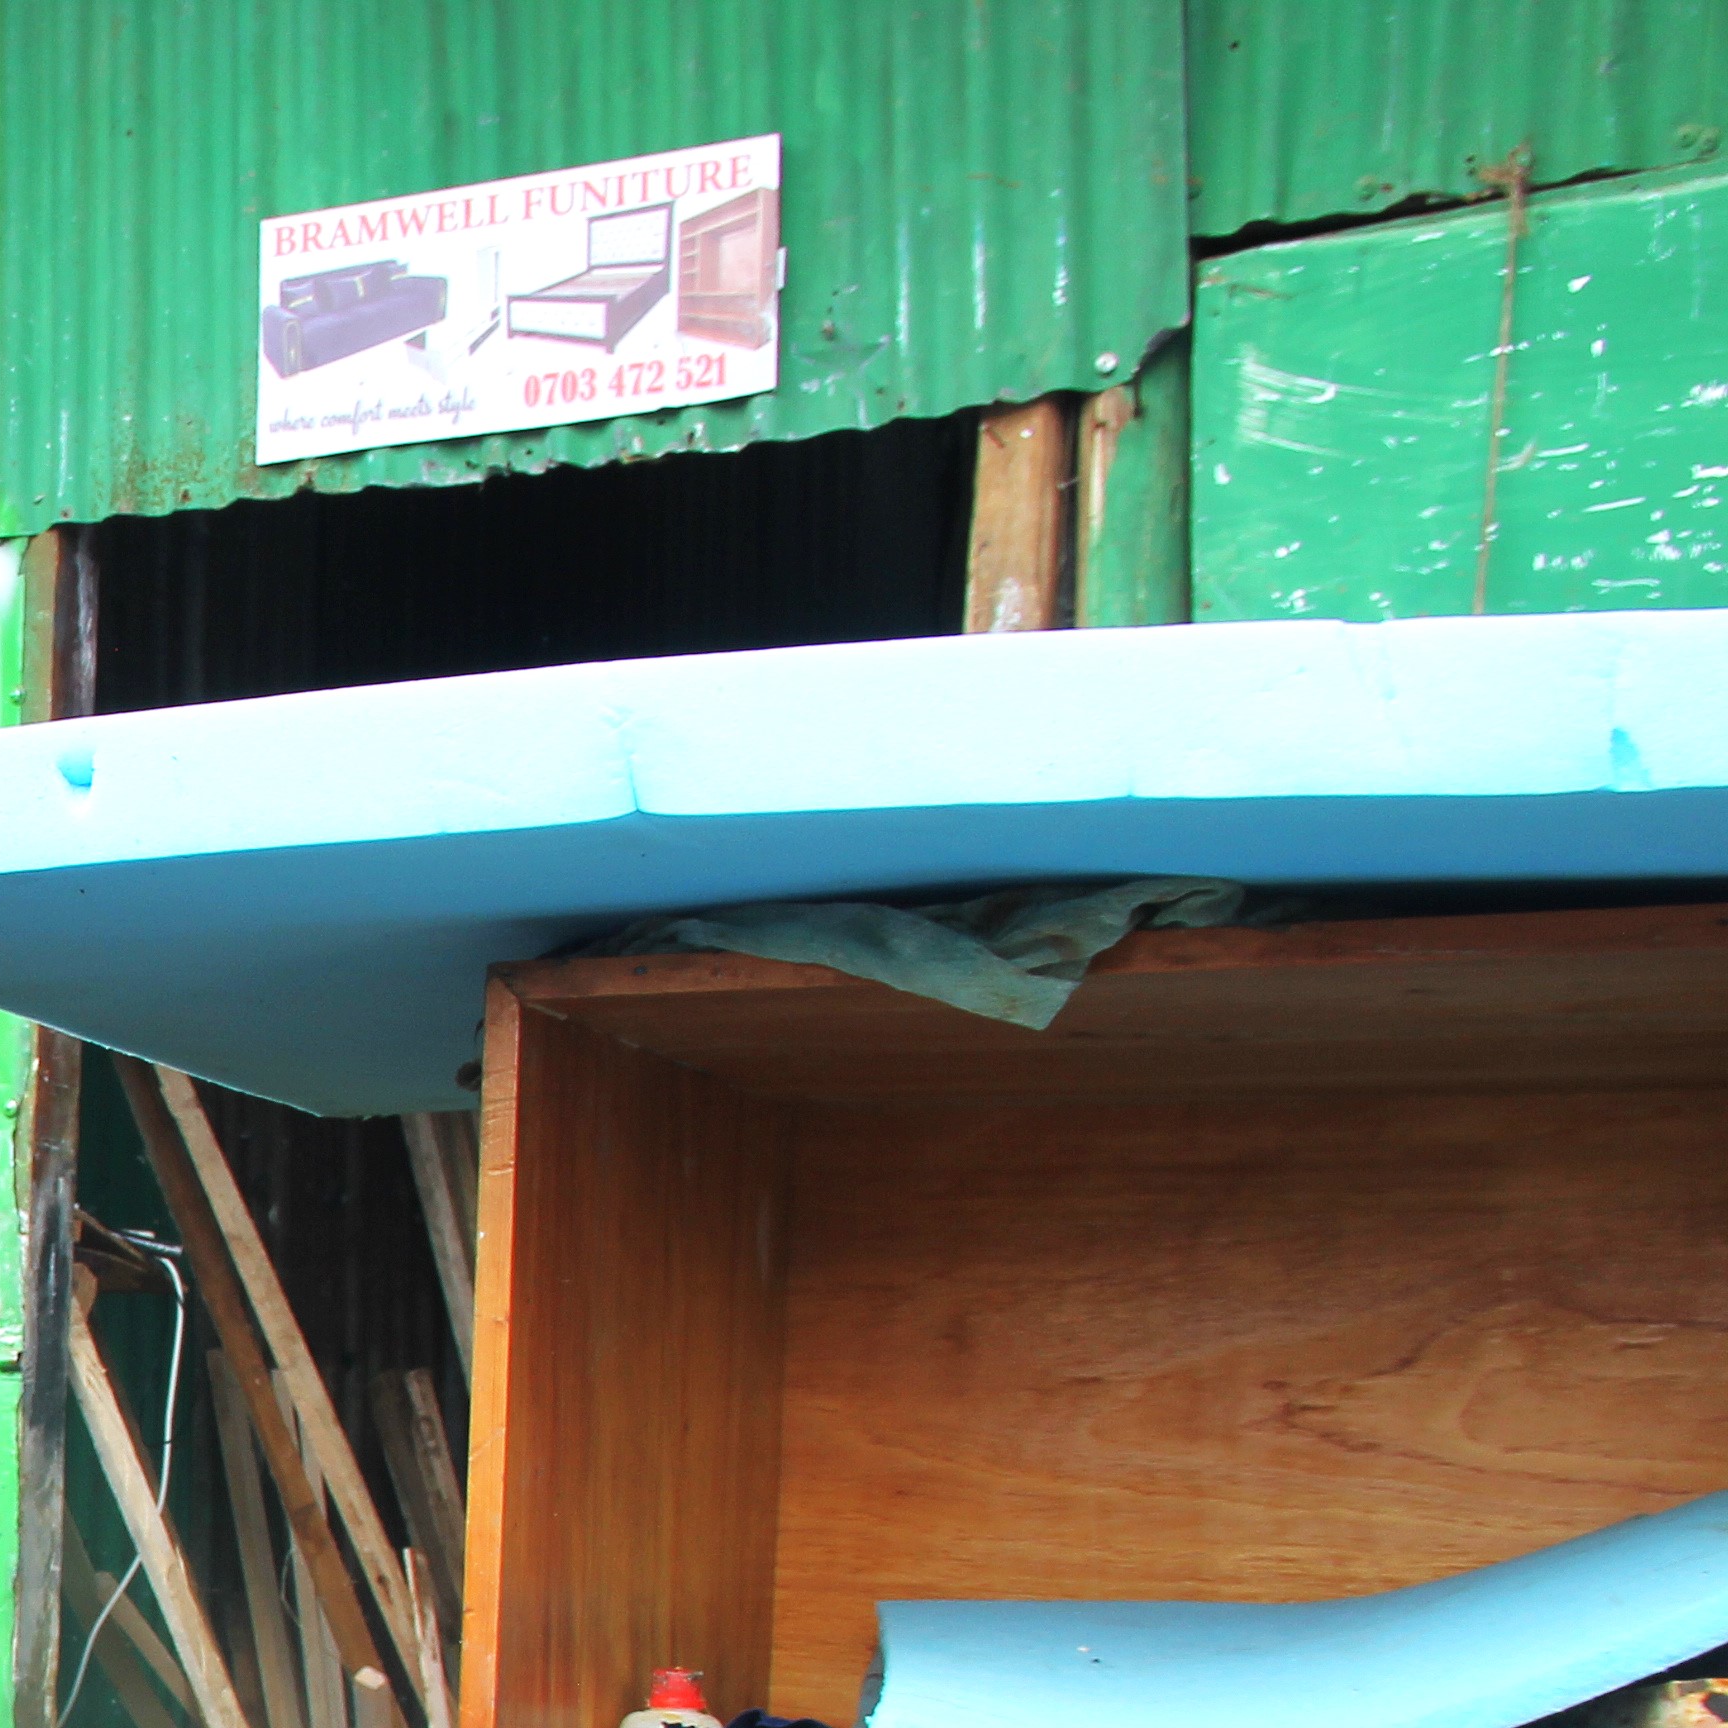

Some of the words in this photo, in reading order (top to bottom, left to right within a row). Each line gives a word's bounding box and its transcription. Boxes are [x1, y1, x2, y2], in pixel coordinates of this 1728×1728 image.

[273, 197, 510, 258] BRAMWELL
[520, 153, 753, 221] FUNITURE
[523, 367, 597, 409] 0703
[608, 360, 665, 399] 472
[675, 352, 728, 391] 521
[268, 407, 315, 433] where
[320, 398, 382, 437] comfort
[388, 393, 433, 420] meets
[437, 385, 477, 425] style
